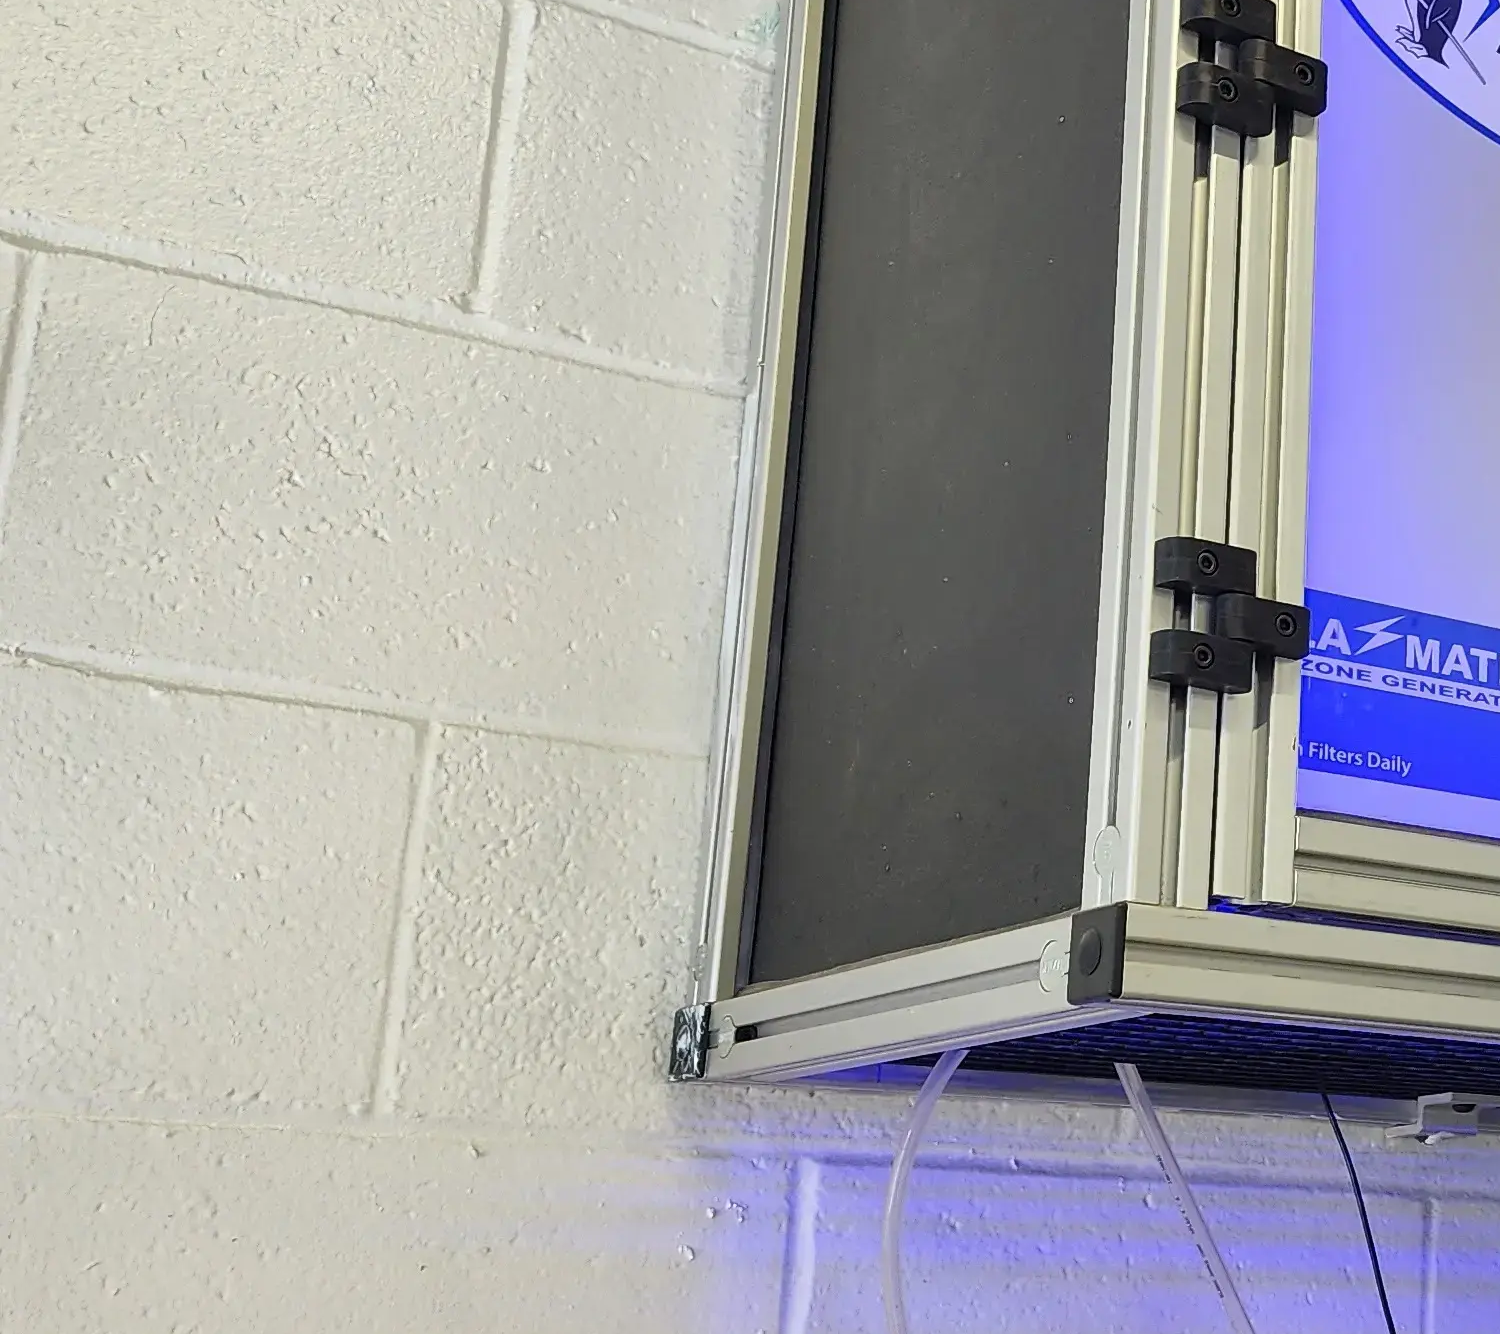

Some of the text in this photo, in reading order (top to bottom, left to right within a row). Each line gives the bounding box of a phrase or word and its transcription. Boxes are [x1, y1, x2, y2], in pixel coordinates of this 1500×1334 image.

[1301, 658, 1373, 683] ZONE
[1308, 740, 1364, 766] Filters
[1367, 750, 1413, 778] Daily
